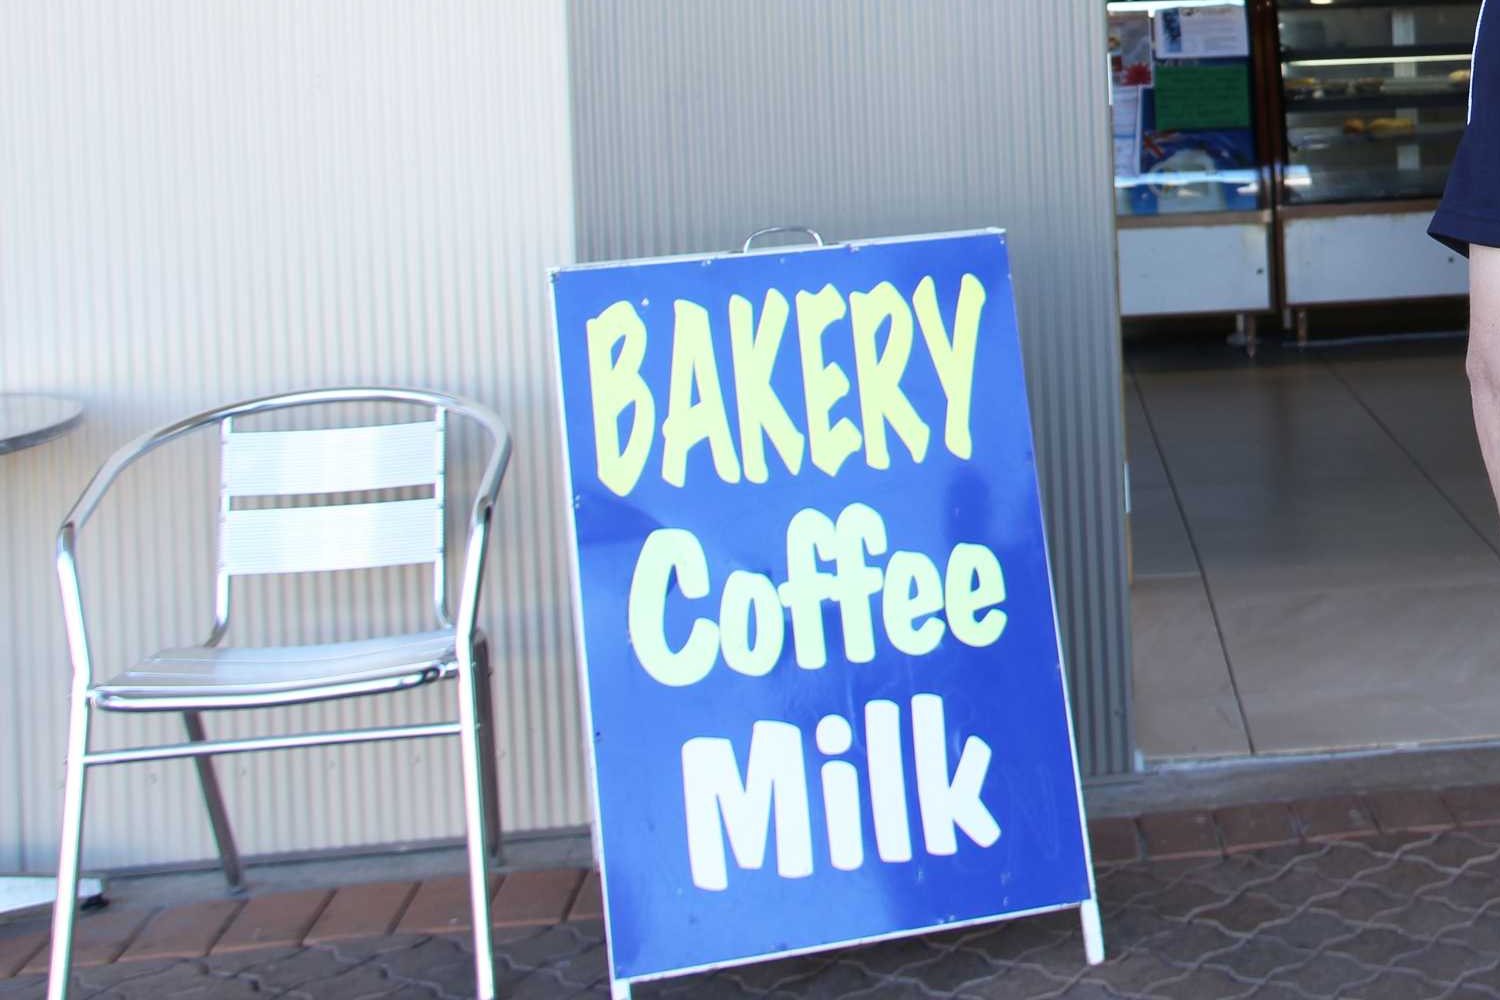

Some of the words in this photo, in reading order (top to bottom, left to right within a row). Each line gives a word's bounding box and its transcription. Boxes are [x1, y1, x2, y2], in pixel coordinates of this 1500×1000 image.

[587, 273, 986, 497] BAKERY
[628, 502, 1008, 687] Coffee
[682, 693, 1002, 890] Milk
